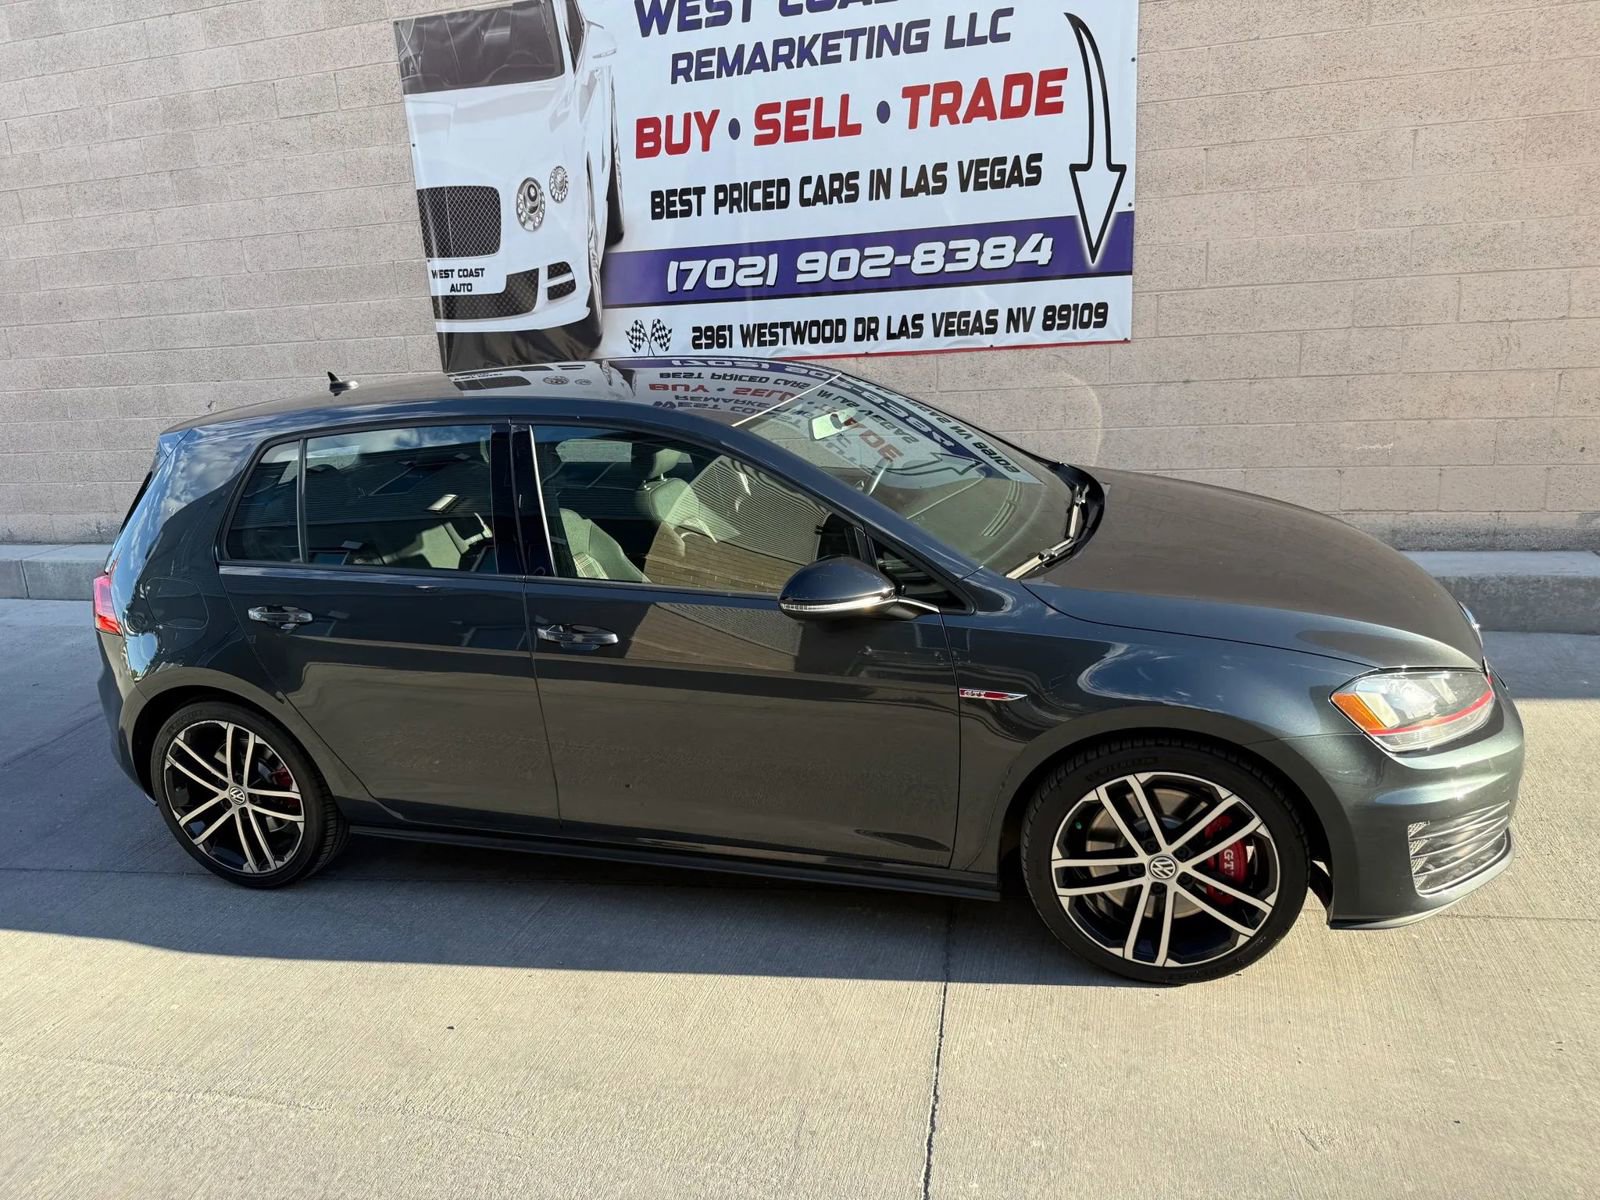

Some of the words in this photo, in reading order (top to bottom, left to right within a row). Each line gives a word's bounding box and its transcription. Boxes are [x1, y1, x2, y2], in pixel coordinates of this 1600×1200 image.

[671, 18, 931, 84] REMARKETING
[944, 7, 1014, 49] LLC
[635, 109, 721, 159] BUY
[754, 93, 862, 146] SELL
[901, 68, 1068, 129] TRADE
[651, 186, 706, 220] BEST
[714, 178, 790, 215] PRICED
[799, 171, 860, 208] CARS
[868, 168, 892, 201] IN
[900, 162, 948, 198] LAS
[957, 153, 1043, 192] VEGAS
[431, 269, 455, 279] WEST
[457, 267, 485, 278] COAST
[449, 282, 473, 293] AUTO
[667, 253, 778, 293] (702)
[796, 233, 1054, 283] 902-8384
[691, 325, 733, 350] 2961
[740, 318, 847, 348] WESTWOOD
[853, 316, 880, 342] DR
[886, 313, 924, 341] LAS
[932, 309, 999, 338] VEGAS
[1006, 306, 1036, 333] NV
[1042, 302, 1109, 332] 89109
